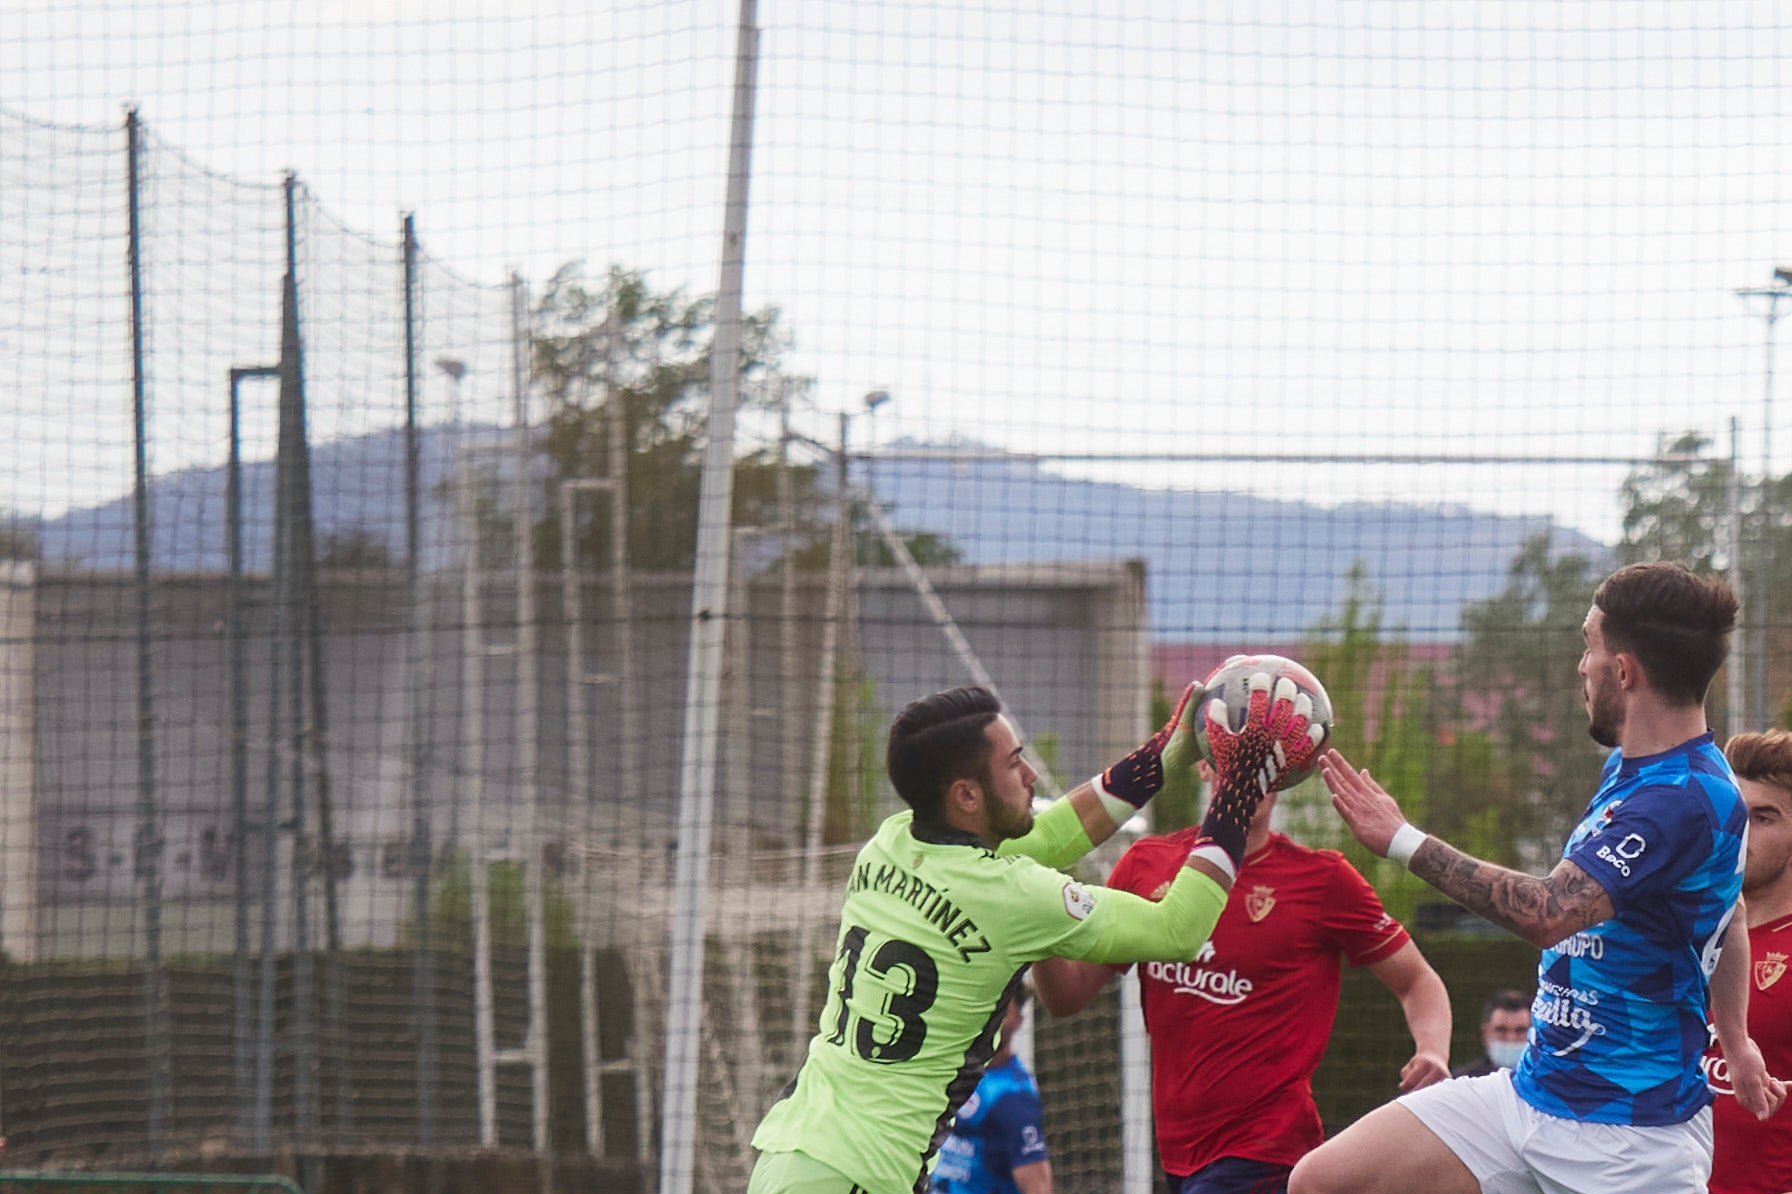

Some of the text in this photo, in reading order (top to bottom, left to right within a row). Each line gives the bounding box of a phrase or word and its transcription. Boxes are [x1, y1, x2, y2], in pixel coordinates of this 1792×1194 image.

[873, 864, 992, 964] MARTÍNEZ
[825, 925, 939, 1065] 13
[1146, 961, 1253, 999] acturale
